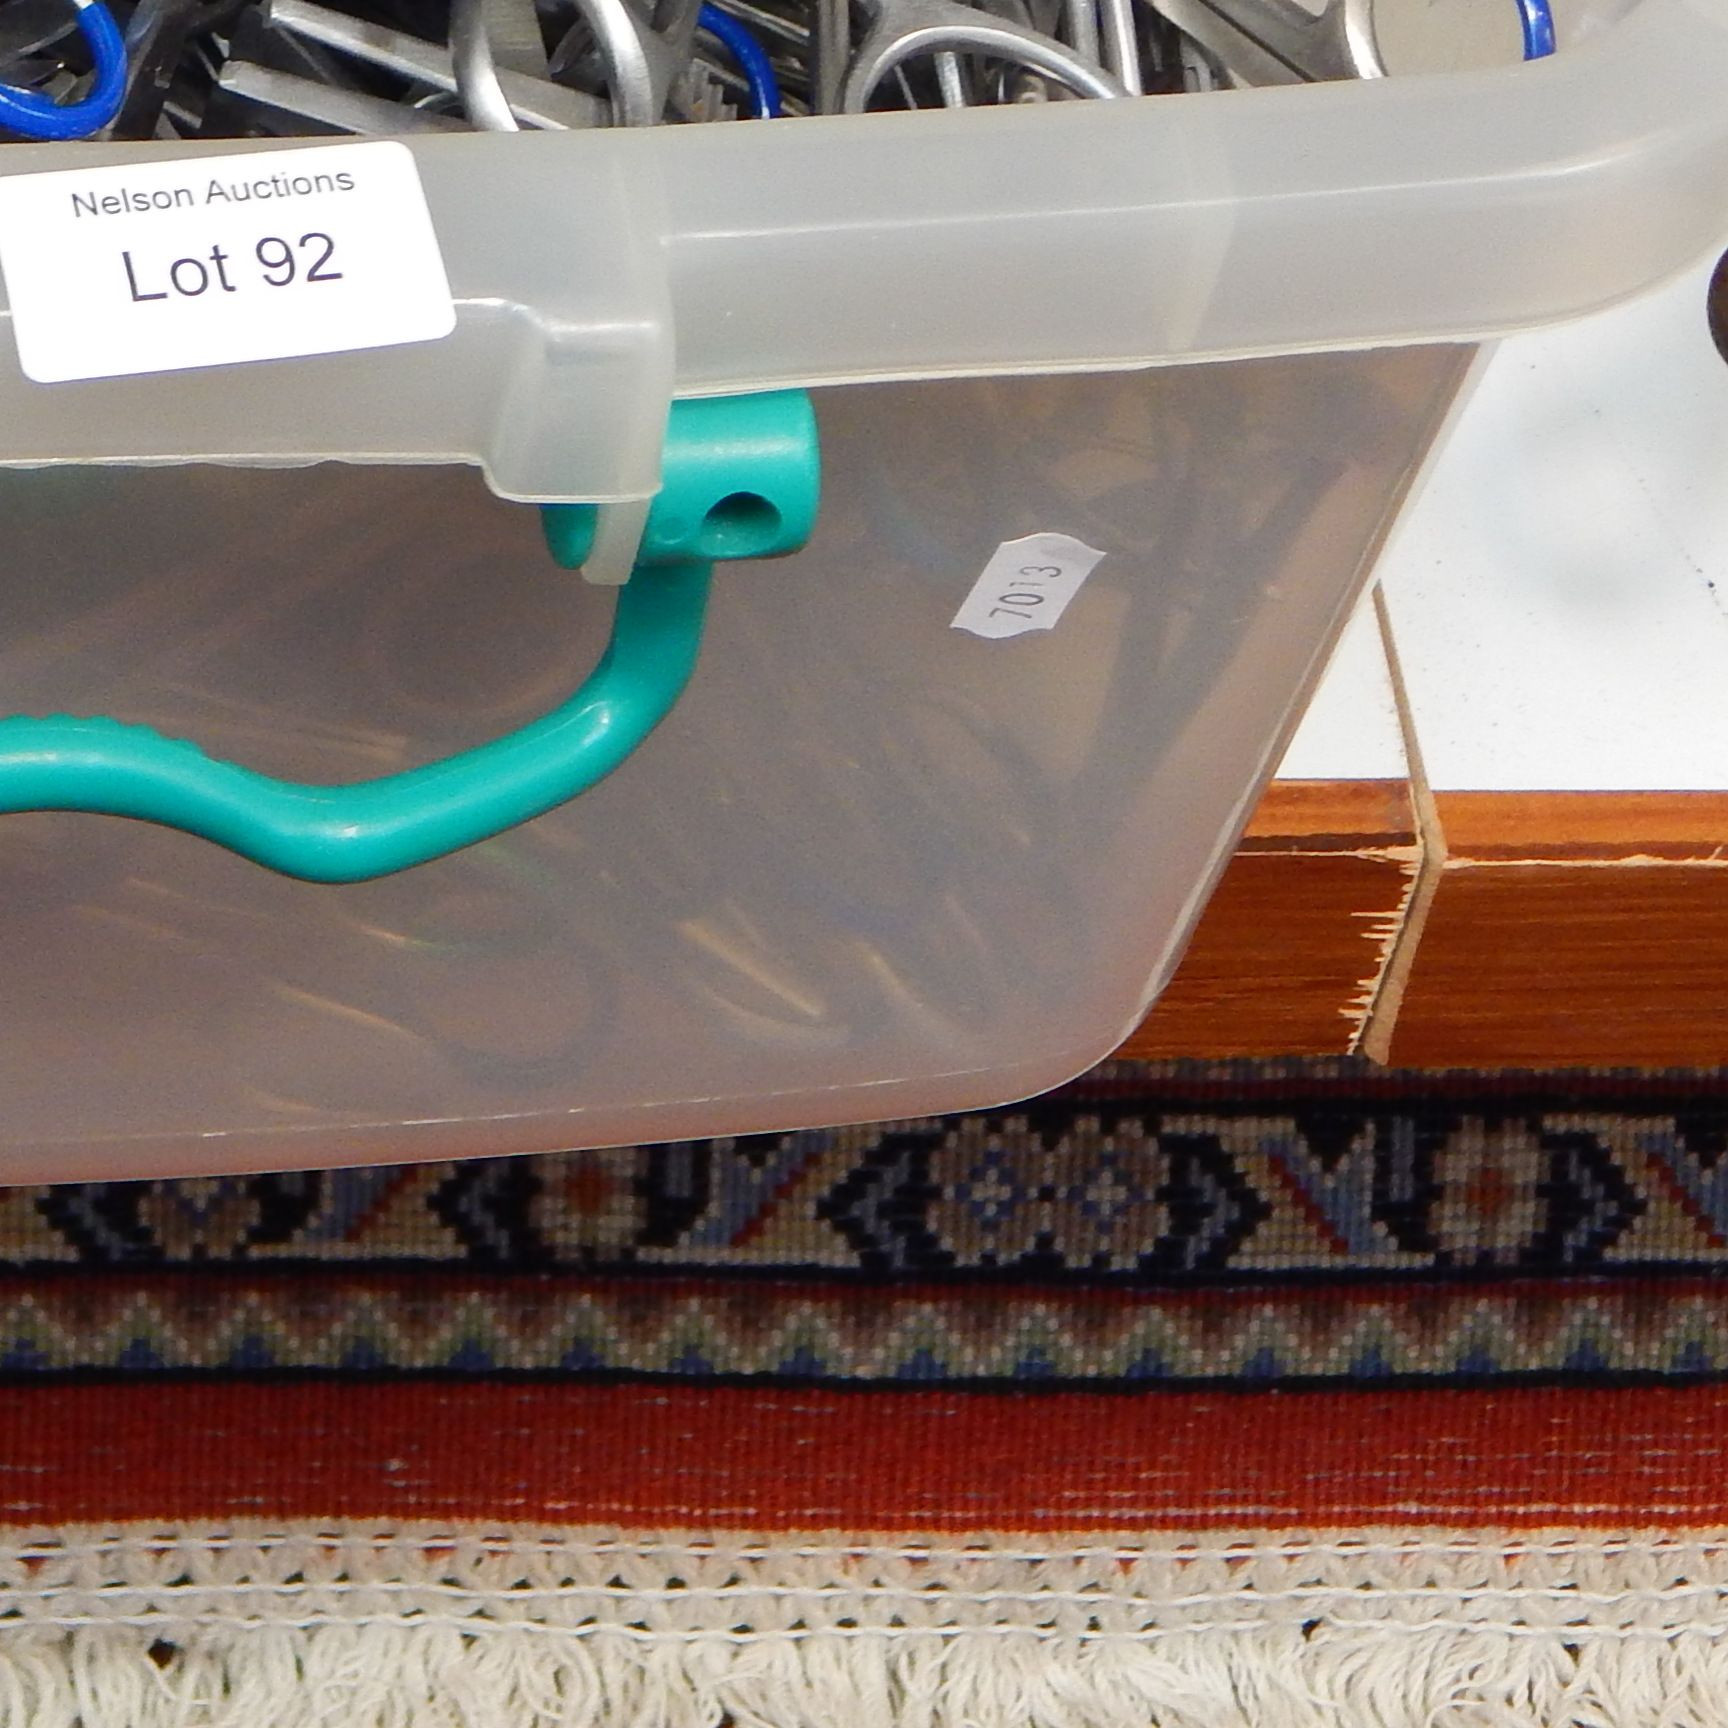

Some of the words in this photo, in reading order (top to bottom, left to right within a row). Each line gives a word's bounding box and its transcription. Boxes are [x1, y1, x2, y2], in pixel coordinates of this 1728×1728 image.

[71, 187, 194, 219] Nelson
[205, 171, 355, 205] Auctions
[121, 244, 237, 302] Lot
[255, 232, 344, 288] 92
[988, 566, 1062, 619] 7013
